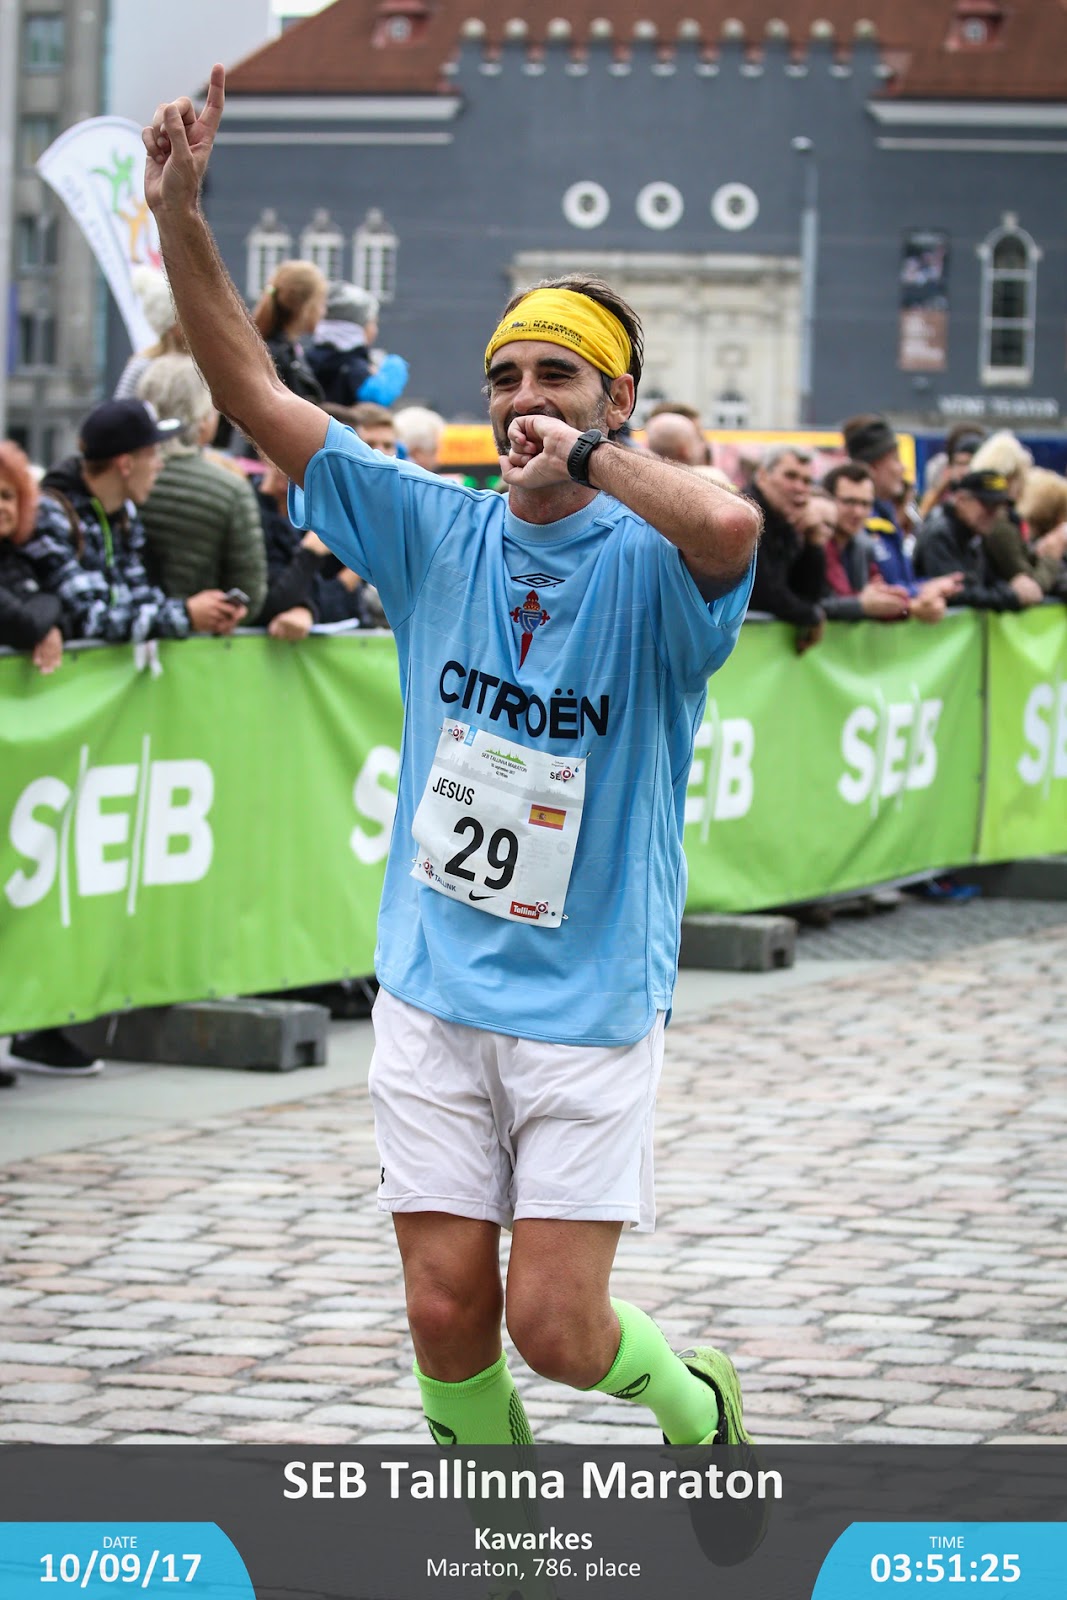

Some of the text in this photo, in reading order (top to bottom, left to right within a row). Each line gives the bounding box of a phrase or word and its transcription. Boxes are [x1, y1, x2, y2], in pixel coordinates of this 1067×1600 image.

[533, 322, 582, 344] MARATHON
[439, 660, 609, 739] CITROËN
[684, 717, 755, 824] EB
[837, 697, 943, 806] SEB
[432, 777, 476, 806] JESUS
[4, 757, 216, 909] SEB
[444, 816, 520, 890] 29
[434, 874, 457, 892] TALLINK
